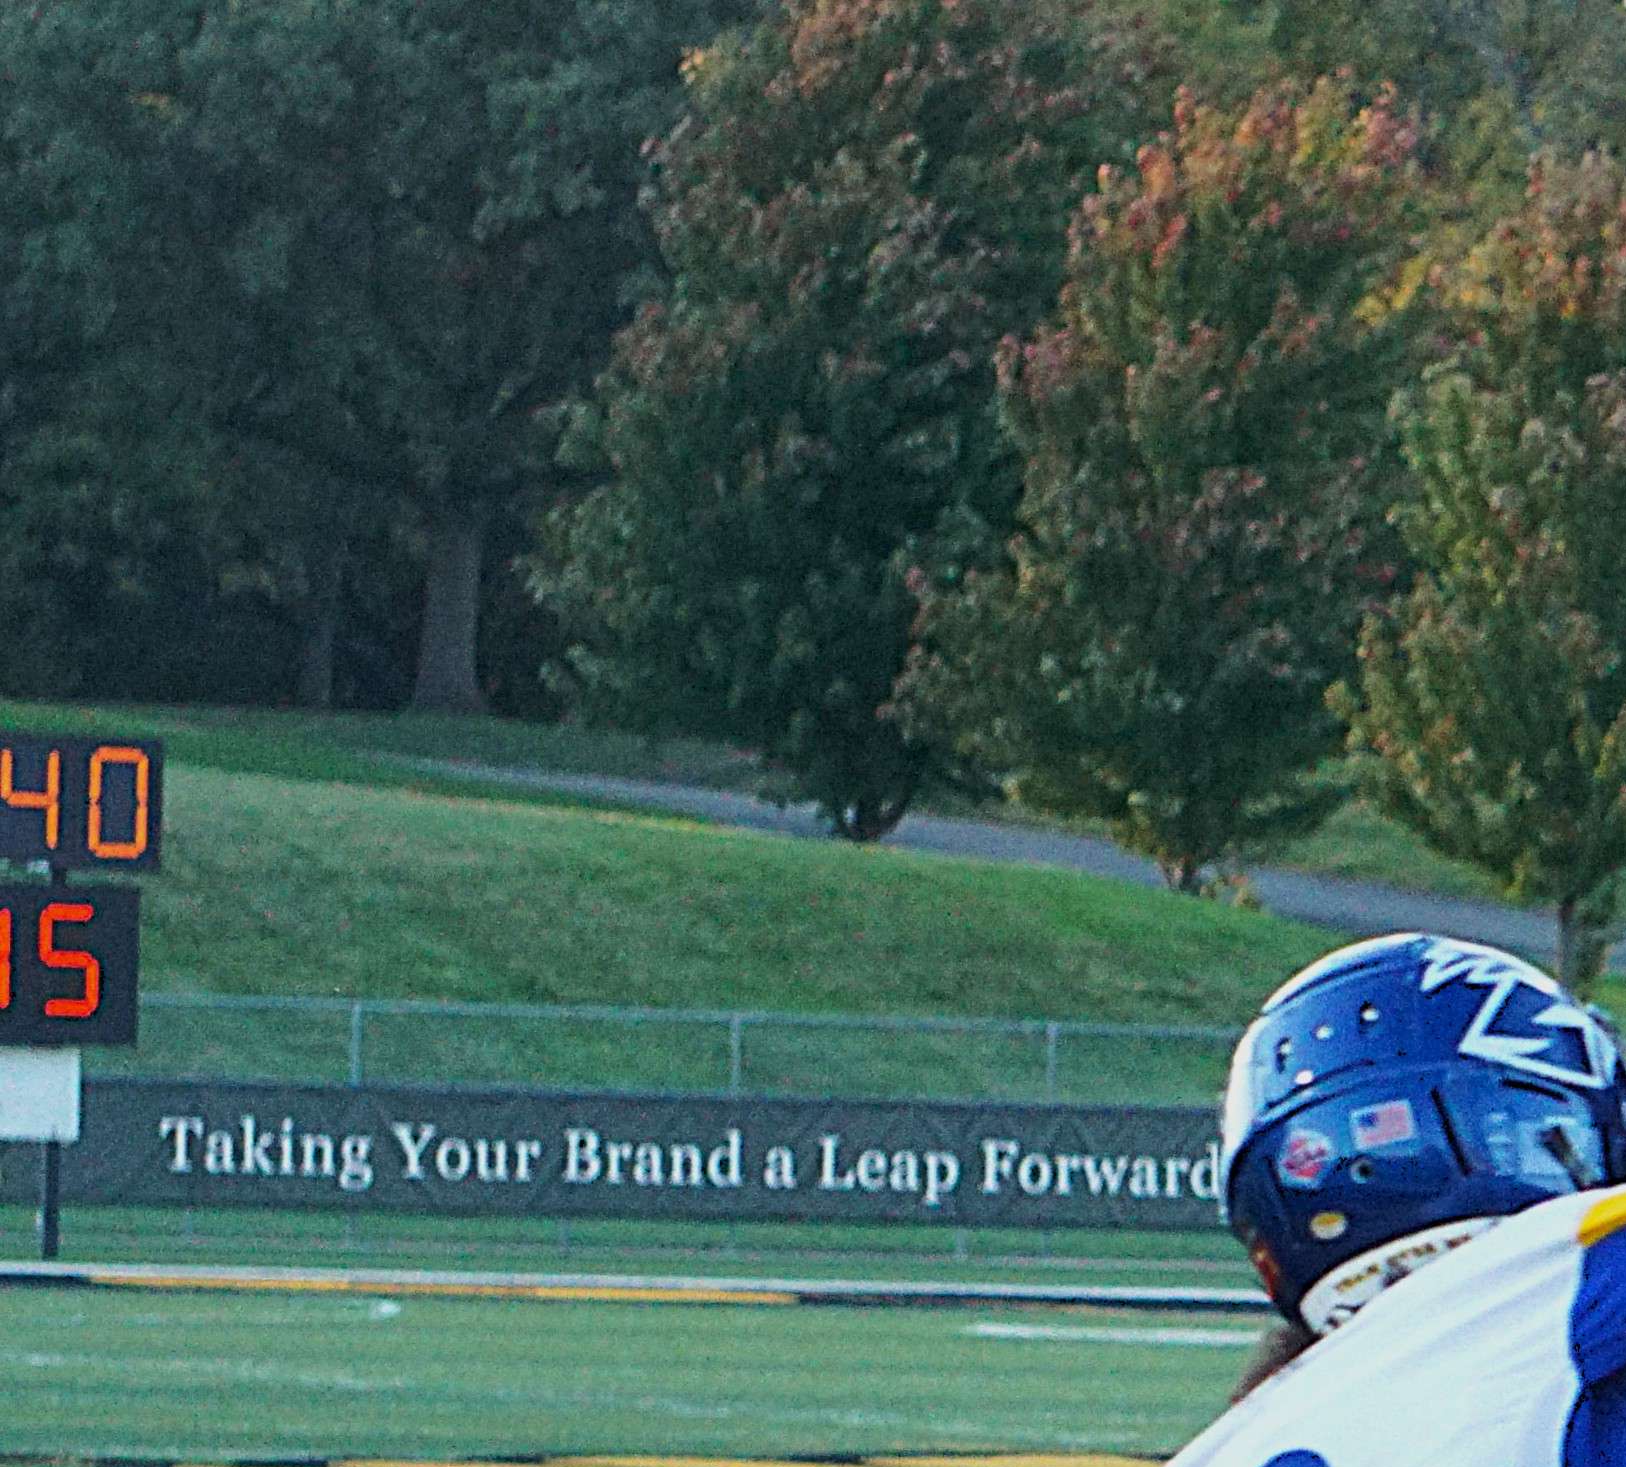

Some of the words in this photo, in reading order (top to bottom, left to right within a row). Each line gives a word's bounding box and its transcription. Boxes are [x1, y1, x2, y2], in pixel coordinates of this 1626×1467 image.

[0, 747, 148, 859] 40
[158, 1113, 374, 1192] Taking
[392, 1121, 542, 1181] Your
[562, 1126, 742, 1187] Brand
[763, 1145, 797, 1189] a
[818, 1132, 960, 1206] Leap
[981, 1137, 1222, 1198] Forward
